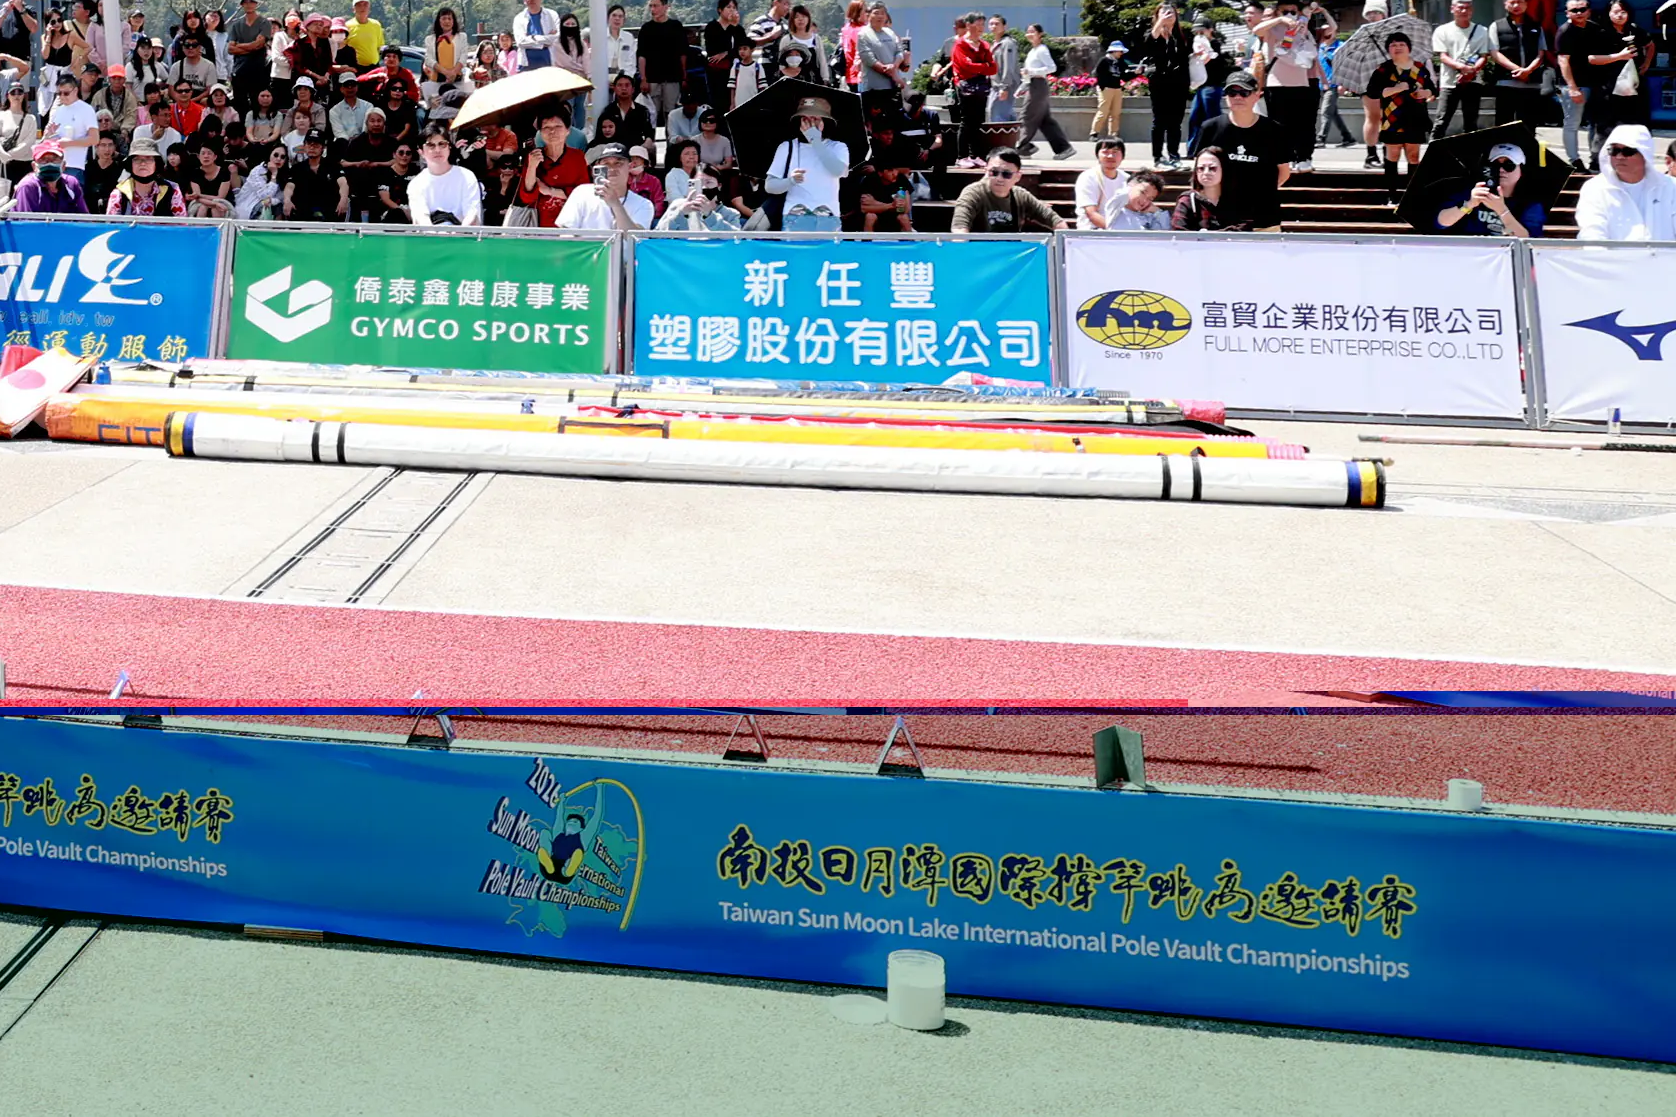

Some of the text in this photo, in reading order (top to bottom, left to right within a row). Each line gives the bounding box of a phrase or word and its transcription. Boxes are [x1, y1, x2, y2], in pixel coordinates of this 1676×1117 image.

[354, 276, 591, 311] 僑泰鑫健康事業
[742, 259, 937, 309] 新任豐
[351, 316, 590, 346] GYMCO SPORTS
[1202, 300, 1503, 336] 富貿企業股份有限公司
[648, 313, 1042, 368] 塑膠股份有限公司
[1104, 350, 1164, 361] Since 1970
[1204, 335, 1248, 353] FULL
[1253, 337, 1304, 355] MORE
[1311, 339, 1423, 358] ENTERPRISE
[487, 797, 515, 838] Sun
[36, 840, 83, 861] Vault
[86, 845, 228, 878] Championships
[479, 859, 621, 913] Pole Vault Championships
[718, 901, 1410, 982] Taiwan Sun Moon Lake International Pole Vault Championships
